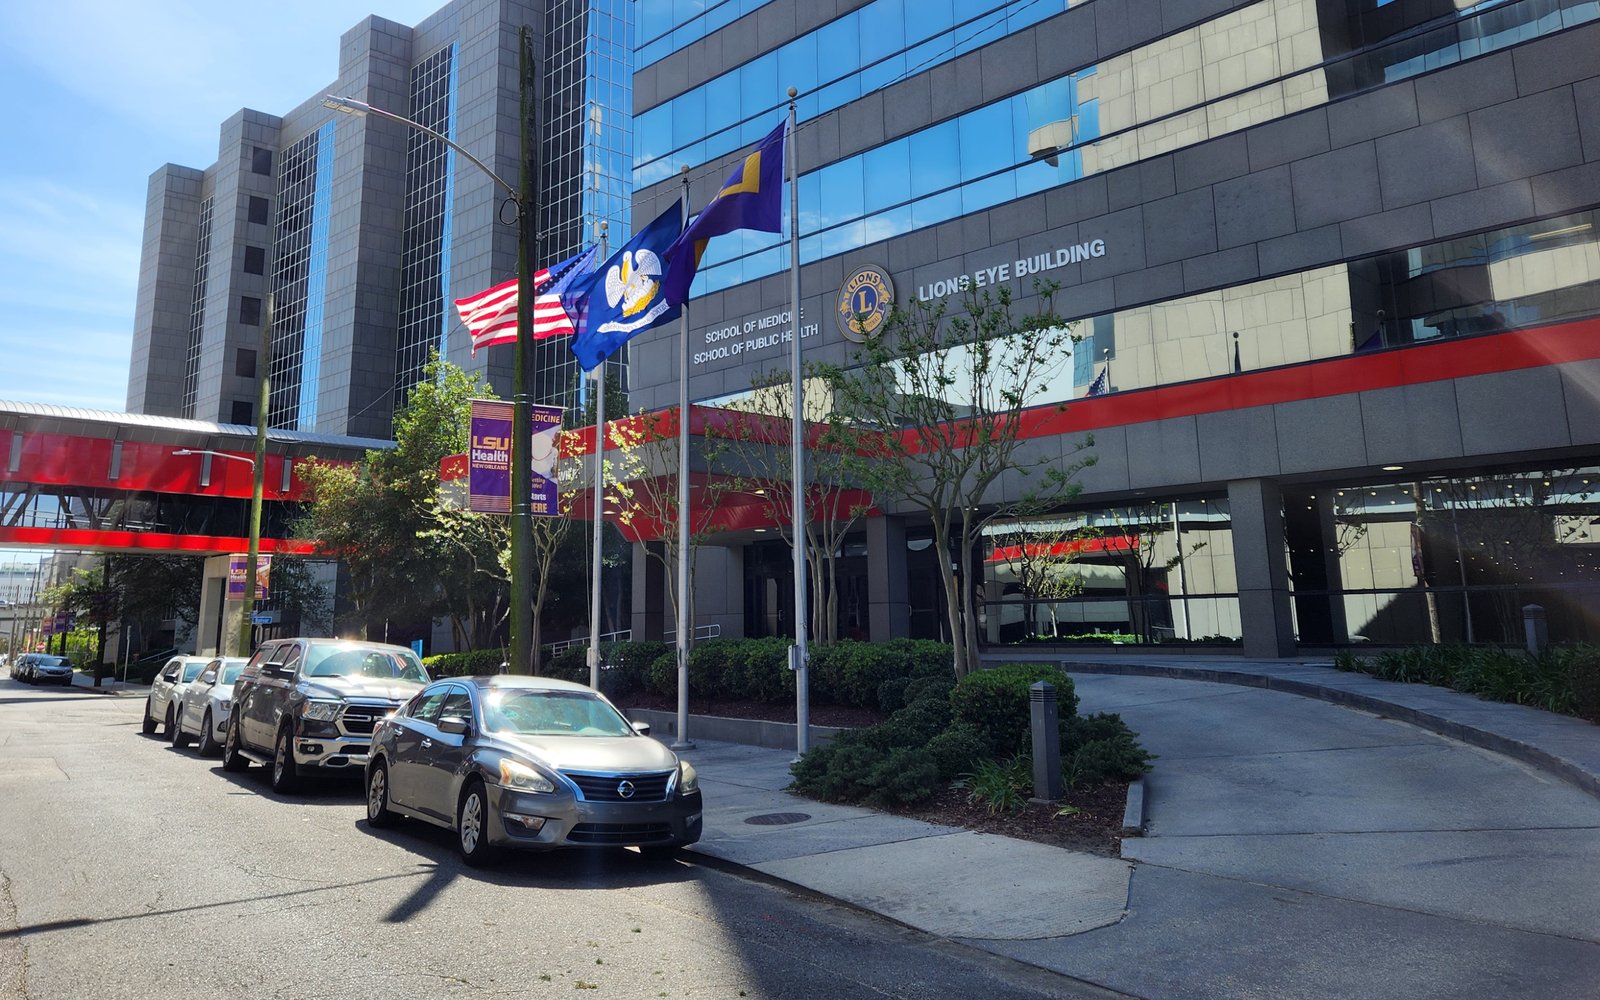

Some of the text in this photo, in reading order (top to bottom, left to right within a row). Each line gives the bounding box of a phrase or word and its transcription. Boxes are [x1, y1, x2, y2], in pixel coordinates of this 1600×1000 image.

[919, 239, 1105, 302] LIONS EYE BUILDING
[849, 273, 879, 290] LIONS
[859, 290, 872, 313] L
[705, 307, 804, 344] SCHOOL OF MEDICIE
[694, 323, 819, 365] SCHOOL OF PUBLIC HELTH
[532, 413, 560, 423] EDICINE
[473, 436, 509, 450] LSU
[472, 449, 508, 462] Health
[531, 503, 547, 512] ERE
